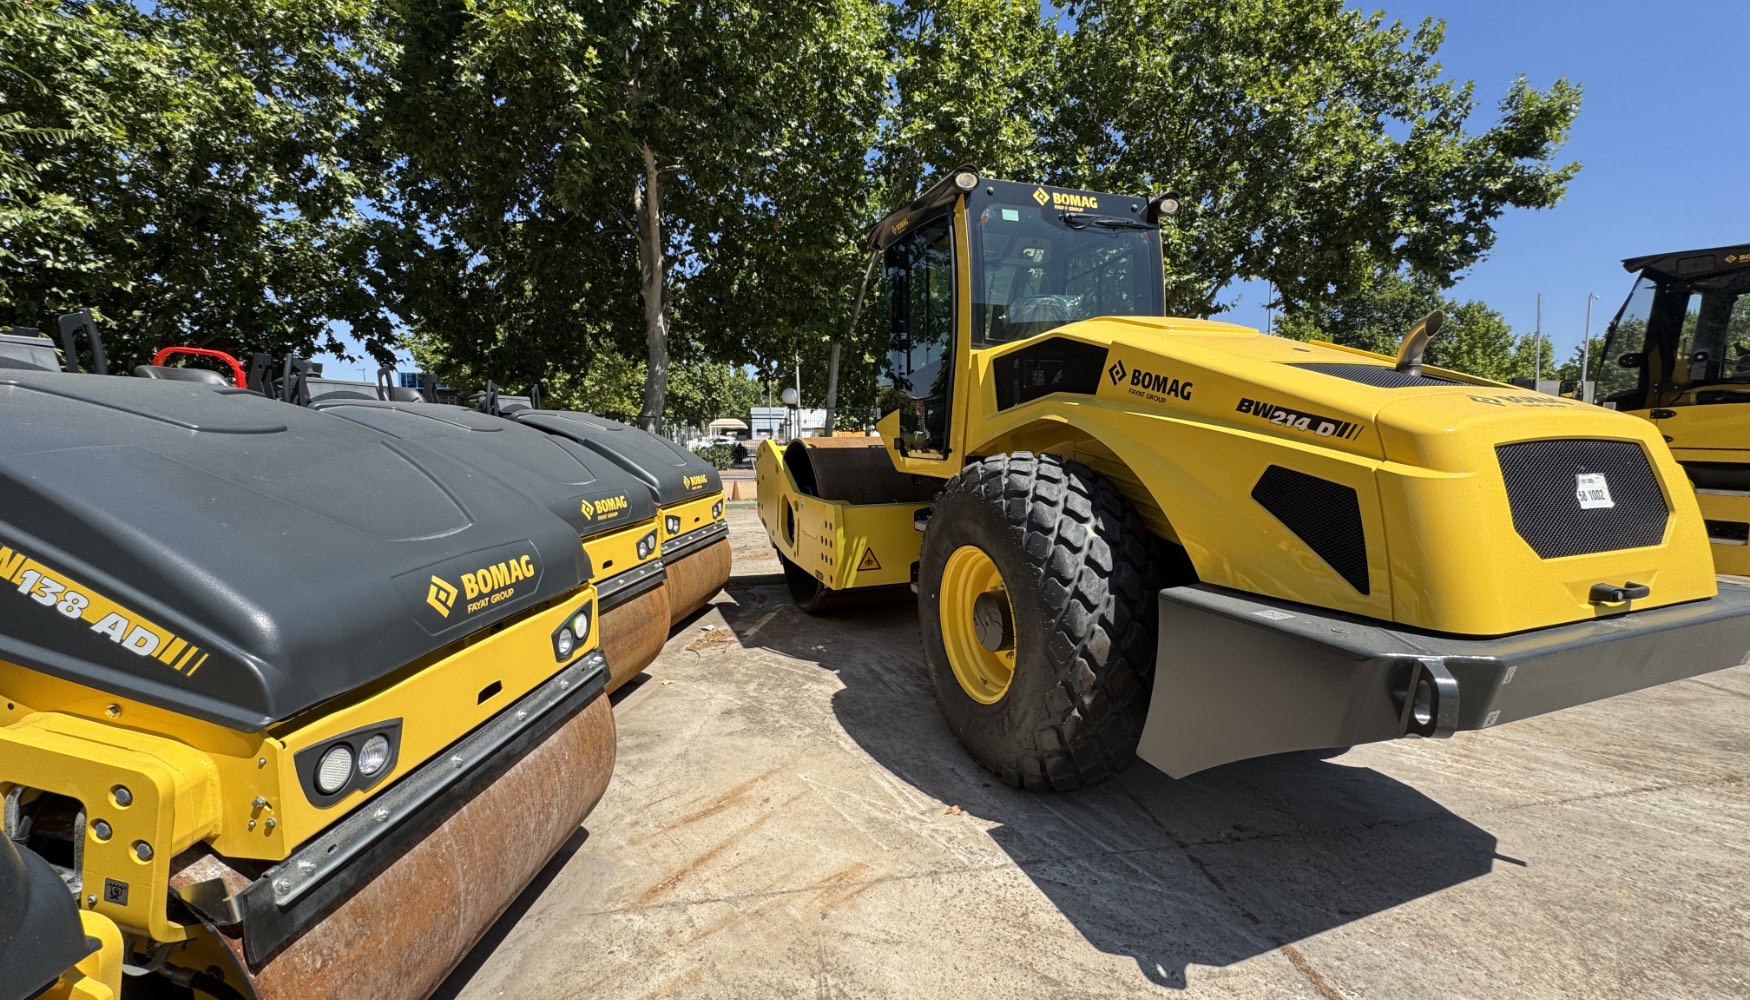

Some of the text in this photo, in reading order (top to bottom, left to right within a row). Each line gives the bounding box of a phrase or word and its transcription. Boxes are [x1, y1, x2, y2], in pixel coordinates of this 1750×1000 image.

[1052, 192, 1098, 209] BOMAG
[1128, 388, 1167, 404] FAYAT GROUP
[1130, 368, 1194, 401] BOMAG
[1314, 421, 1336, 437] D
[594, 495, 628, 514] BOMAG
[460, 554, 535, 600] BOMAG
[467, 587, 515, 614] FAYAT GROUP
[90, 611, 160, 657] AD
